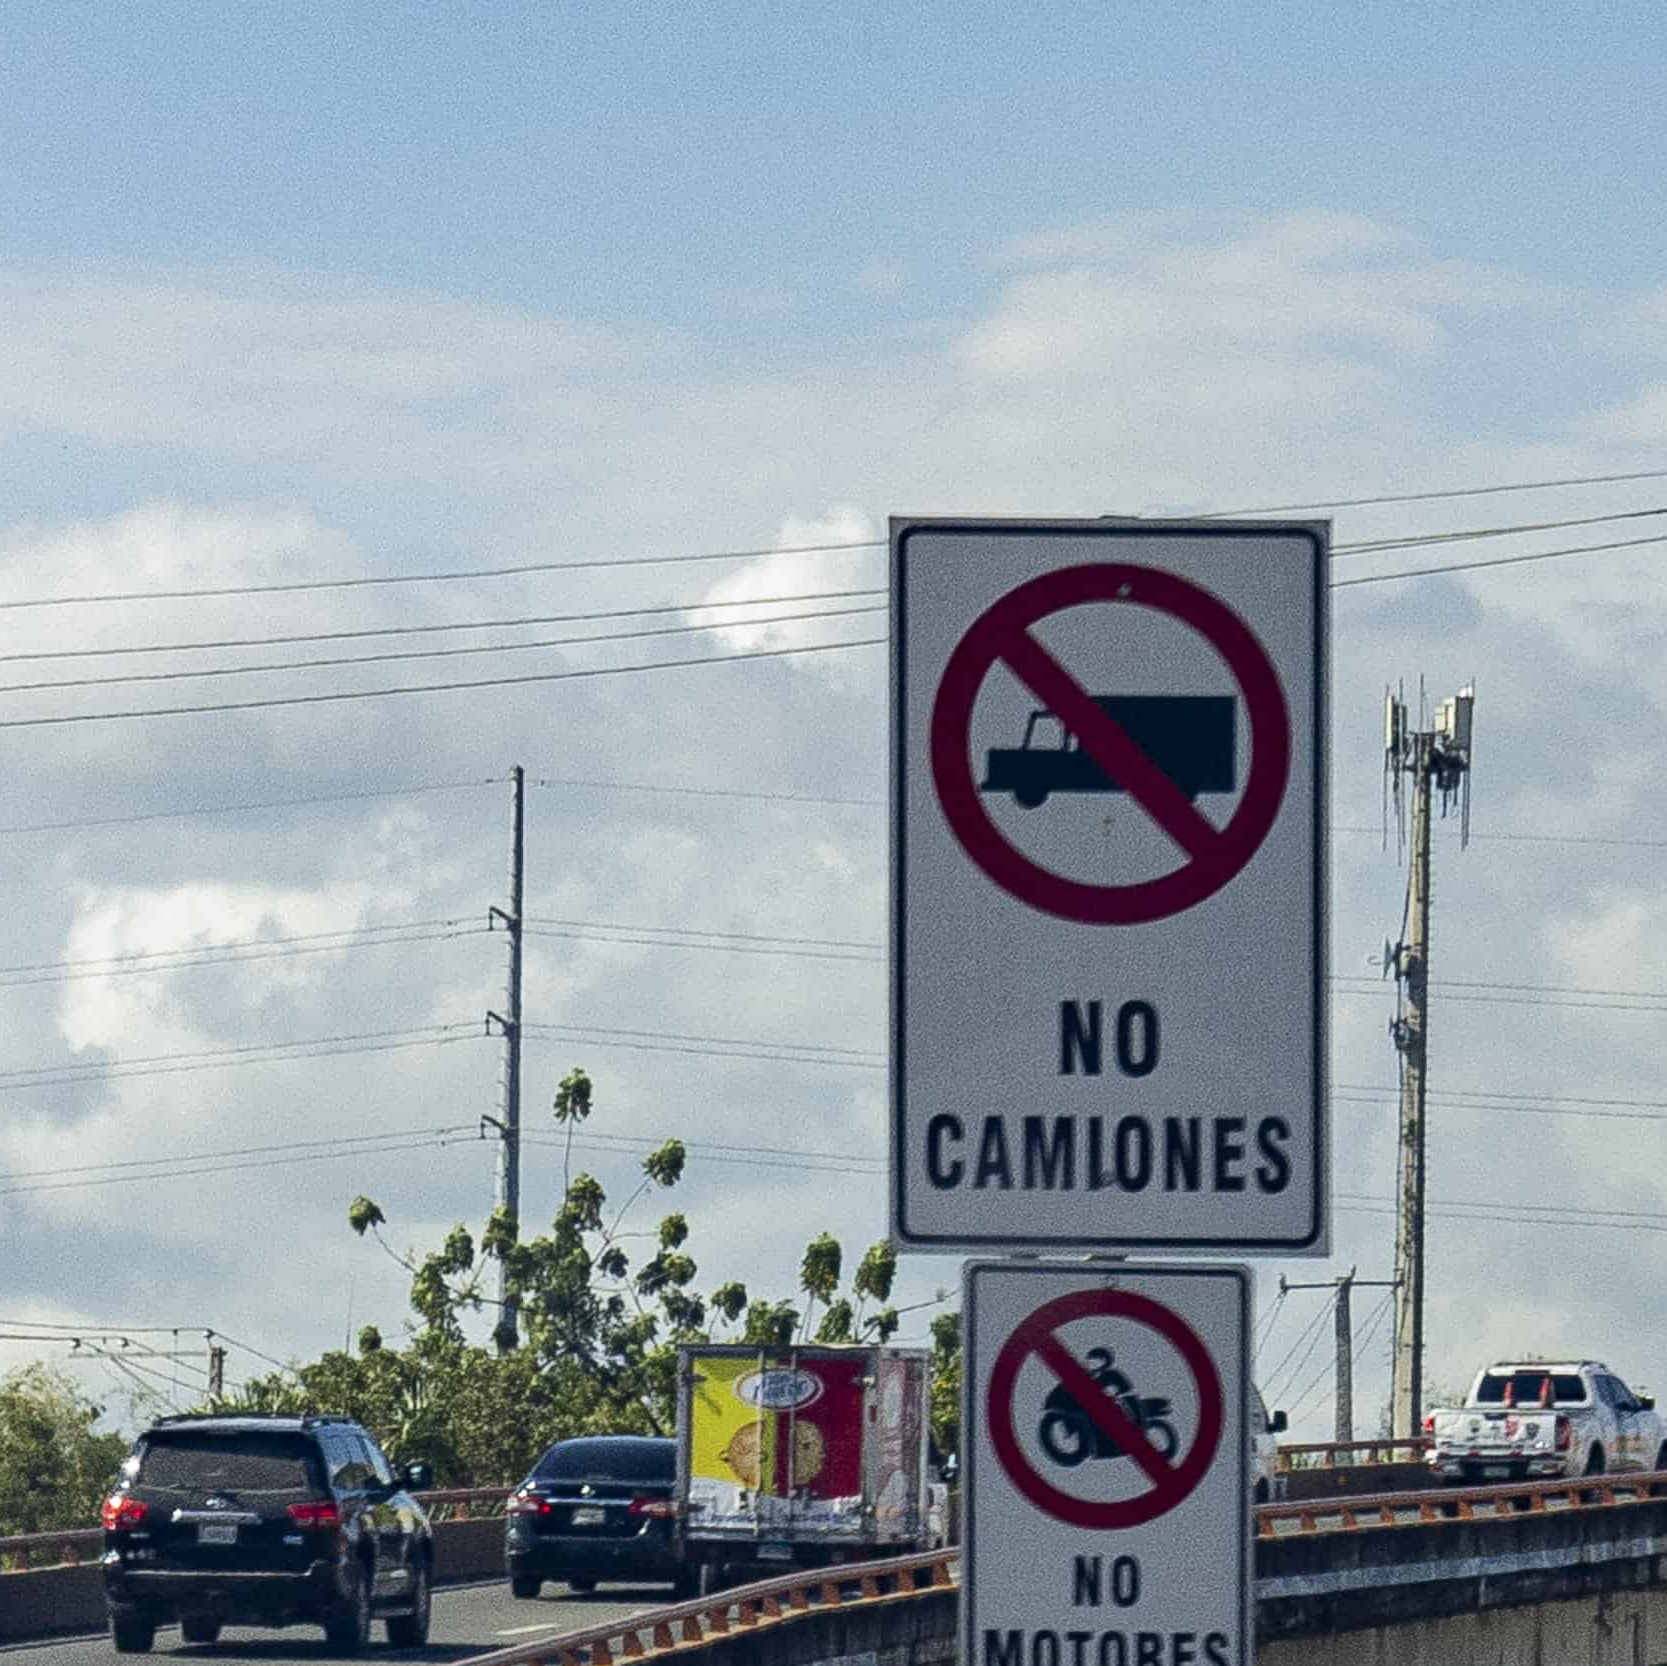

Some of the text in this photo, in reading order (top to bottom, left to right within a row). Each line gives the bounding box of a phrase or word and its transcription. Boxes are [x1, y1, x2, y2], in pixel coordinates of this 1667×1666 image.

[1058, 1000, 1158, 1079] NO
[926, 1112, 1292, 1194] CAMIONES
[1072, 1555, 1141, 1608] NO
